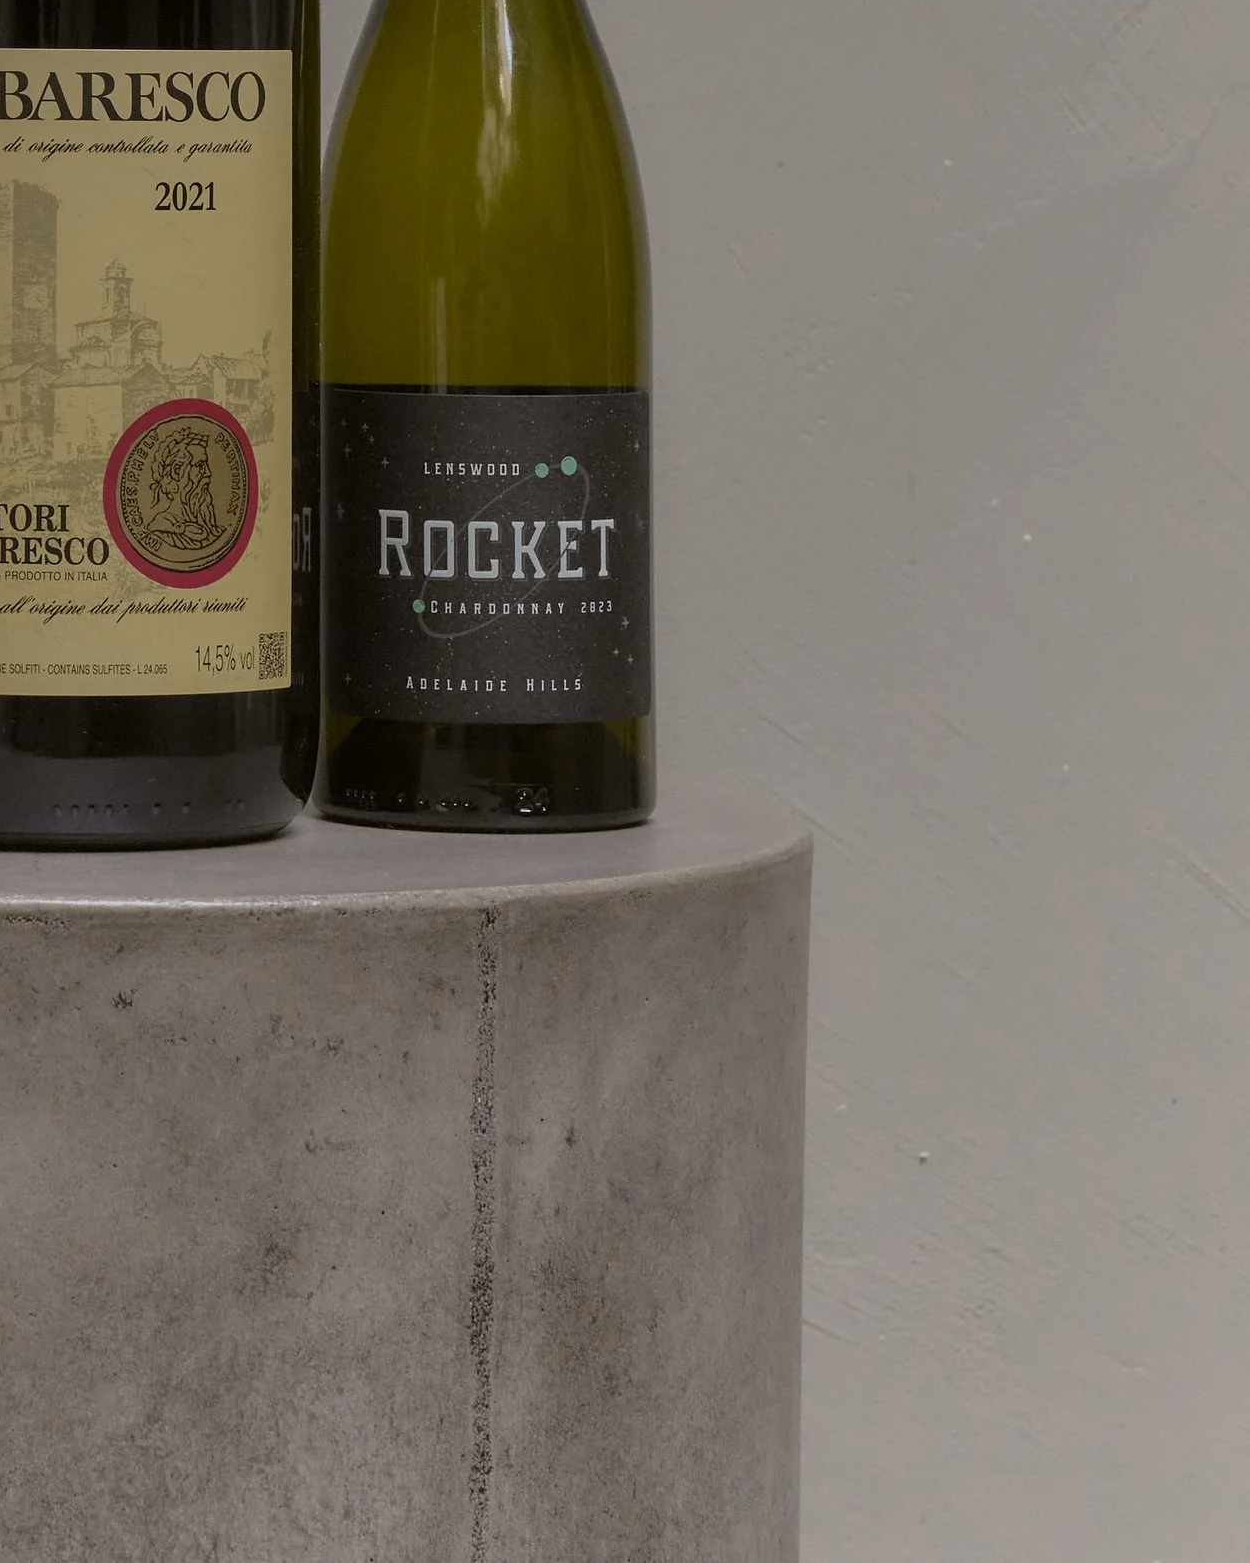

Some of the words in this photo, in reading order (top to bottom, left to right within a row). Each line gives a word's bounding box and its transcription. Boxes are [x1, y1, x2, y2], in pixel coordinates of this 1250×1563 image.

[2, 136, 24, 153] di
[26, 138, 83, 162] origine
[87, 135, 169, 154] controllata
[175, 143, 186, 154] e
[183, 139, 252, 163] garantita
[155, 182, 216, 211] 2021
[424, 462, 520, 476] LENSWOOD
[378, 509, 615, 579] ROCKET
[5, 570, 62, 581] PRODOTTO
[64, 570, 75, 581] IN
[78, 571, 108, 581] ITALIA
[88, 597, 123, 614] dai
[116, 597, 201, 623] produttori
[203, 598, 249, 612] riuniti
[431, 600, 565, 615] CHARDONNAY
[9, 663, 40, 675] SOLFITI
[47, 664, 91, 675] CONTAINS
[92, 664, 131, 675] SULFITES
[195, 644, 237, 676] 14,5%
[240, 645, 255, 670] vol
[406, 676, 507, 692] ADELAIDE
[526, 678, 581, 692] HILLS
